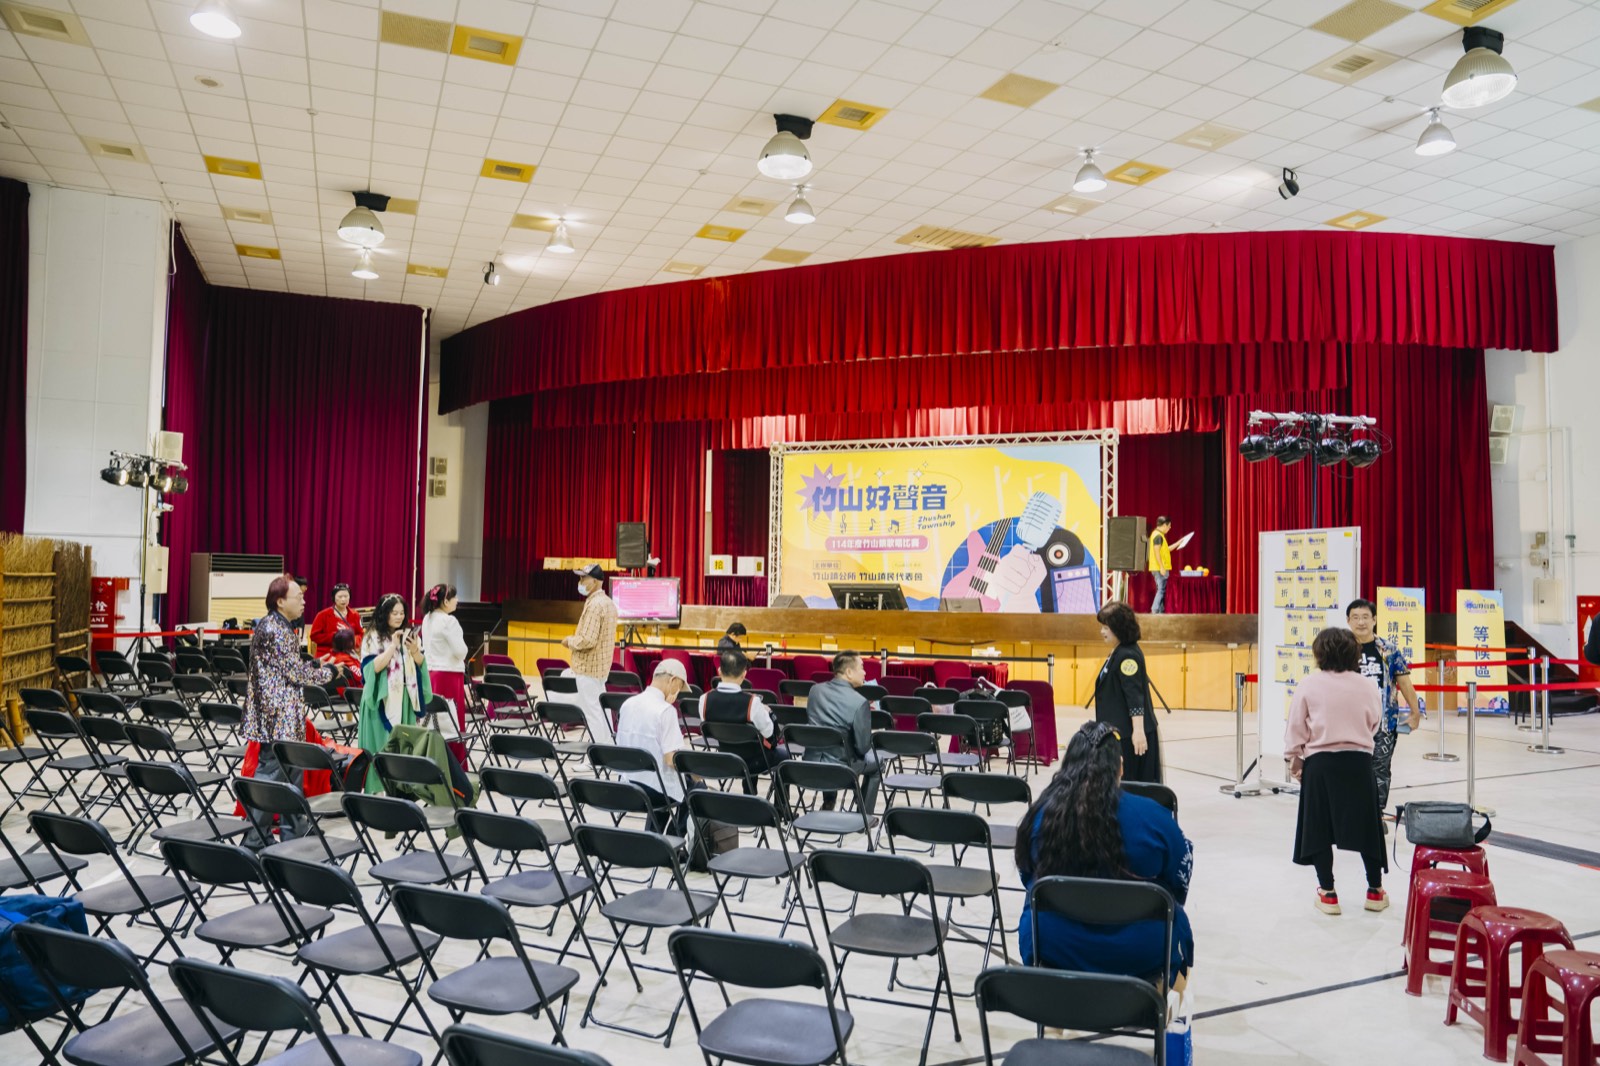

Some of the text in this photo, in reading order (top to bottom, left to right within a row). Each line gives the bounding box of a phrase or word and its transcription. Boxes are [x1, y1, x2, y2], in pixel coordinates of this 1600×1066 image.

[811, 484, 948, 512] 竹山好聲音
[917, 520, 956, 531] Township
[918, 513, 952, 523] Zhushan
[1473, 626, 1490, 678] 等候區
